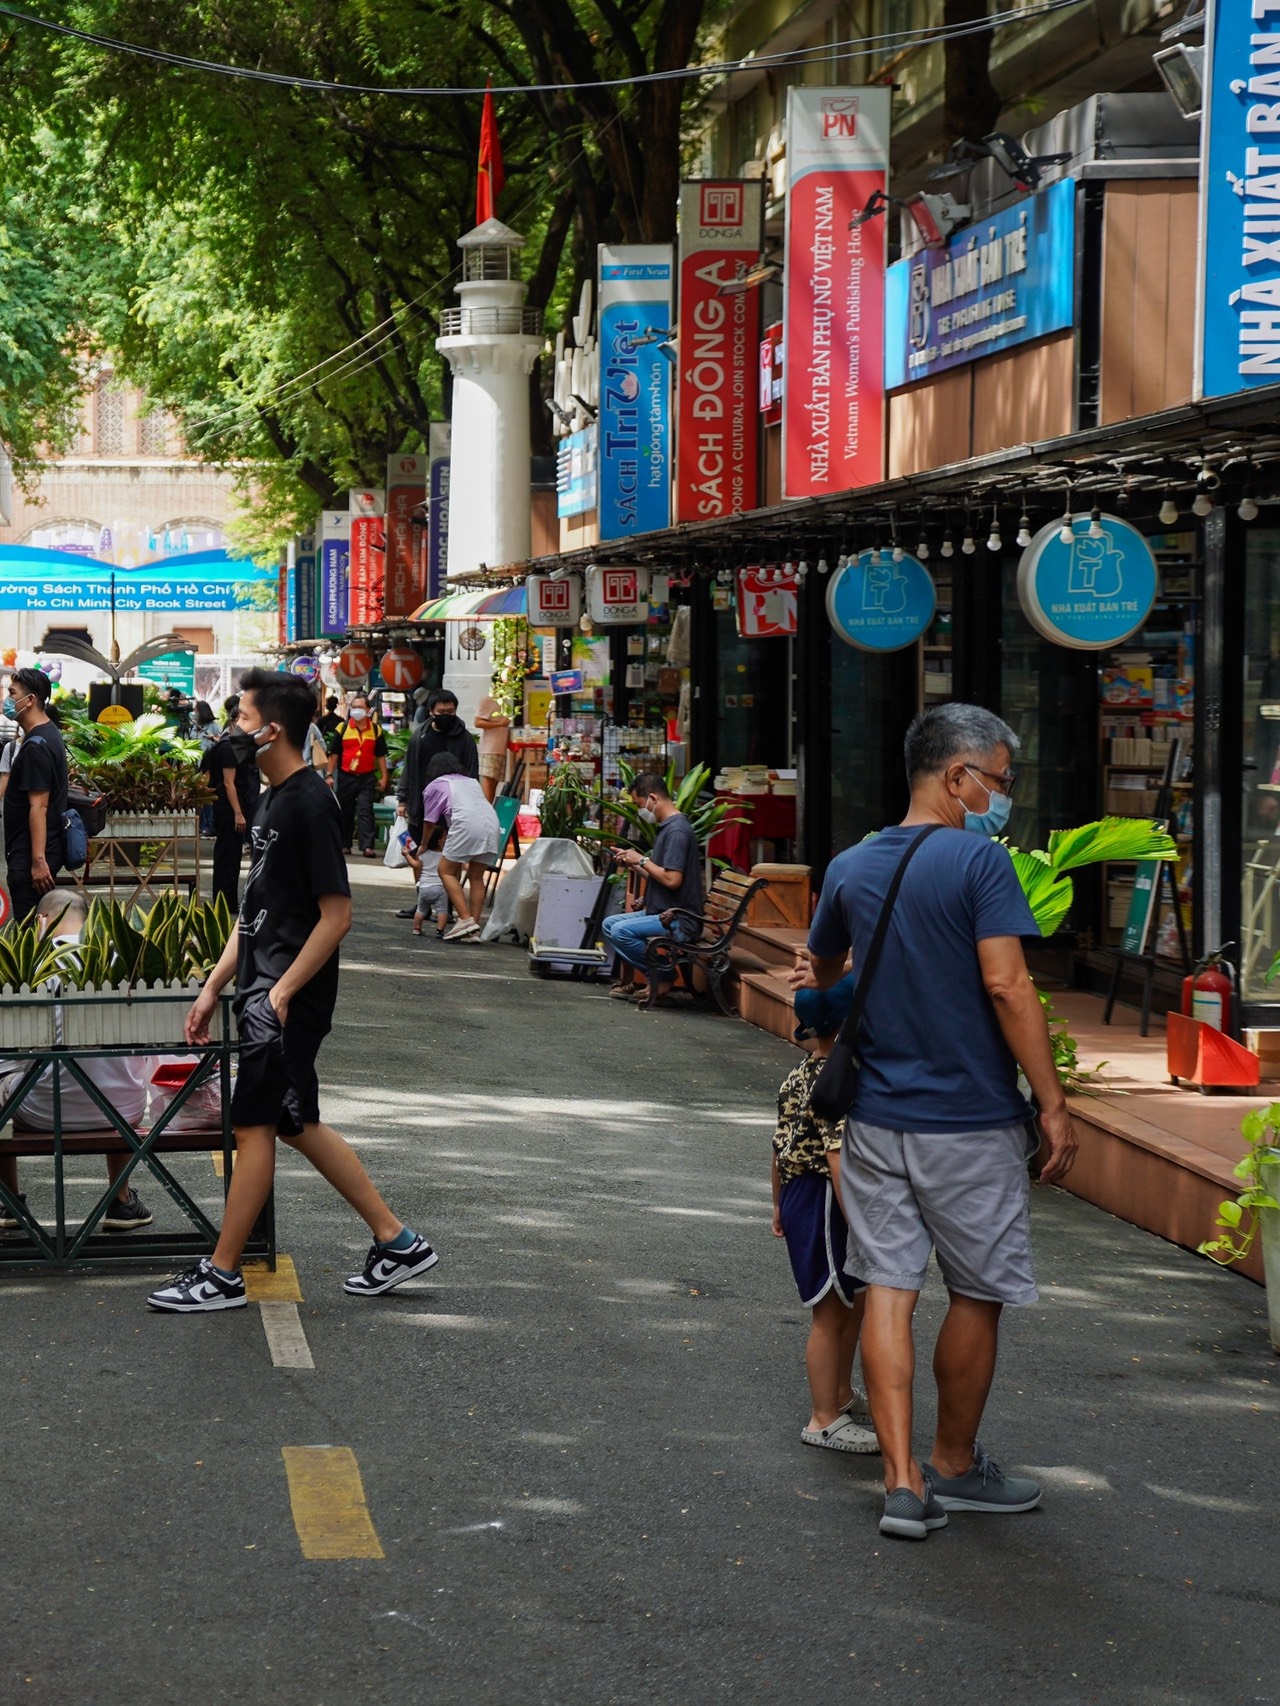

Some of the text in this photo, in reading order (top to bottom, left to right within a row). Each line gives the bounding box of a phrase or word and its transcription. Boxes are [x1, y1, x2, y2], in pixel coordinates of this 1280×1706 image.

[622, 266, 669, 277] First News
[733, 327, 746, 367] STOCK
[803, 186, 836, 482] NHÀ XUẤT BẢN PHỤ NỮ VIỆT NAM
[844, 208, 865, 460] Vietnam Women's Publishing Houe
[685, 258, 726, 515] SÁCH ĐÔNG A
[732, 370, 745, 399] JOIN
[732, 401, 745, 461] CULTURAL
[732, 463, 744, 473] A
[614, 460, 638, 527] SÁCH
[27, 598, 226, 610] Ho Chi Minh City Book Street
[42, 583, 82, 595] Sách
[140, 583, 170, 595] Phố
[176, 582, 198, 595] Hồ
[202, 584, 231, 596] Chí
